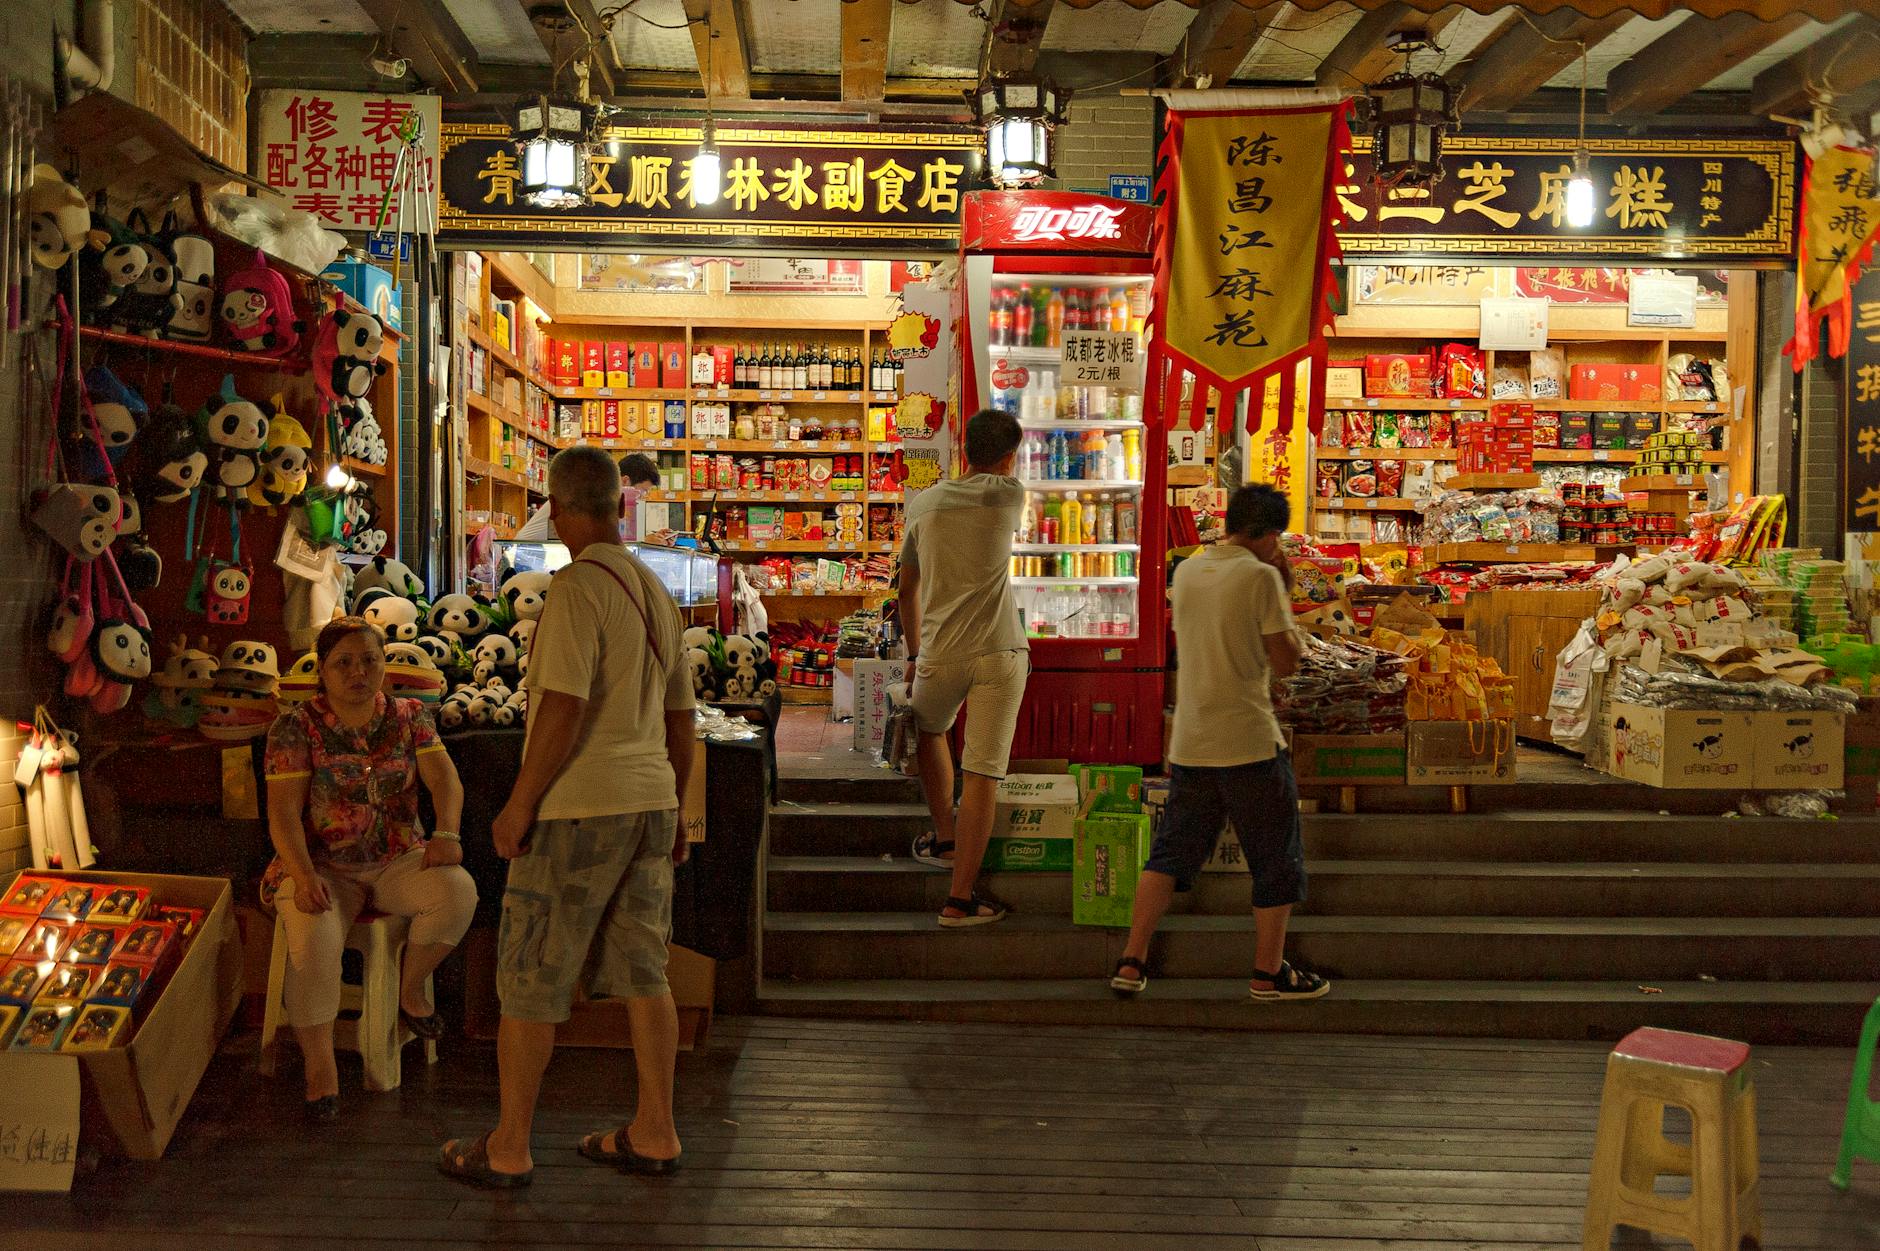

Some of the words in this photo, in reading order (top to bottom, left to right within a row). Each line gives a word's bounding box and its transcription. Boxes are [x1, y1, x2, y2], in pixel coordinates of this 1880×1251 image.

[285, 96, 412, 144] 修表
[267, 143, 435, 193] 配各种电池
[478, 150, 964, 214] 青区顺林冰副食店
[292, 192, 398, 226] 表带
[1121, 188, 1137, 199] 附3
[1700, 161, 1723, 229] 四川特产
[1012, 204, 1127, 241] 可口可乐
[1204, 131, 1283, 347] 陈昌江麻花
[1065, 336, 1134, 363] 成都老冰棍
[1077, 366, 1121, 381] 2元/根
[1000, 782, 1032, 790] estbon
